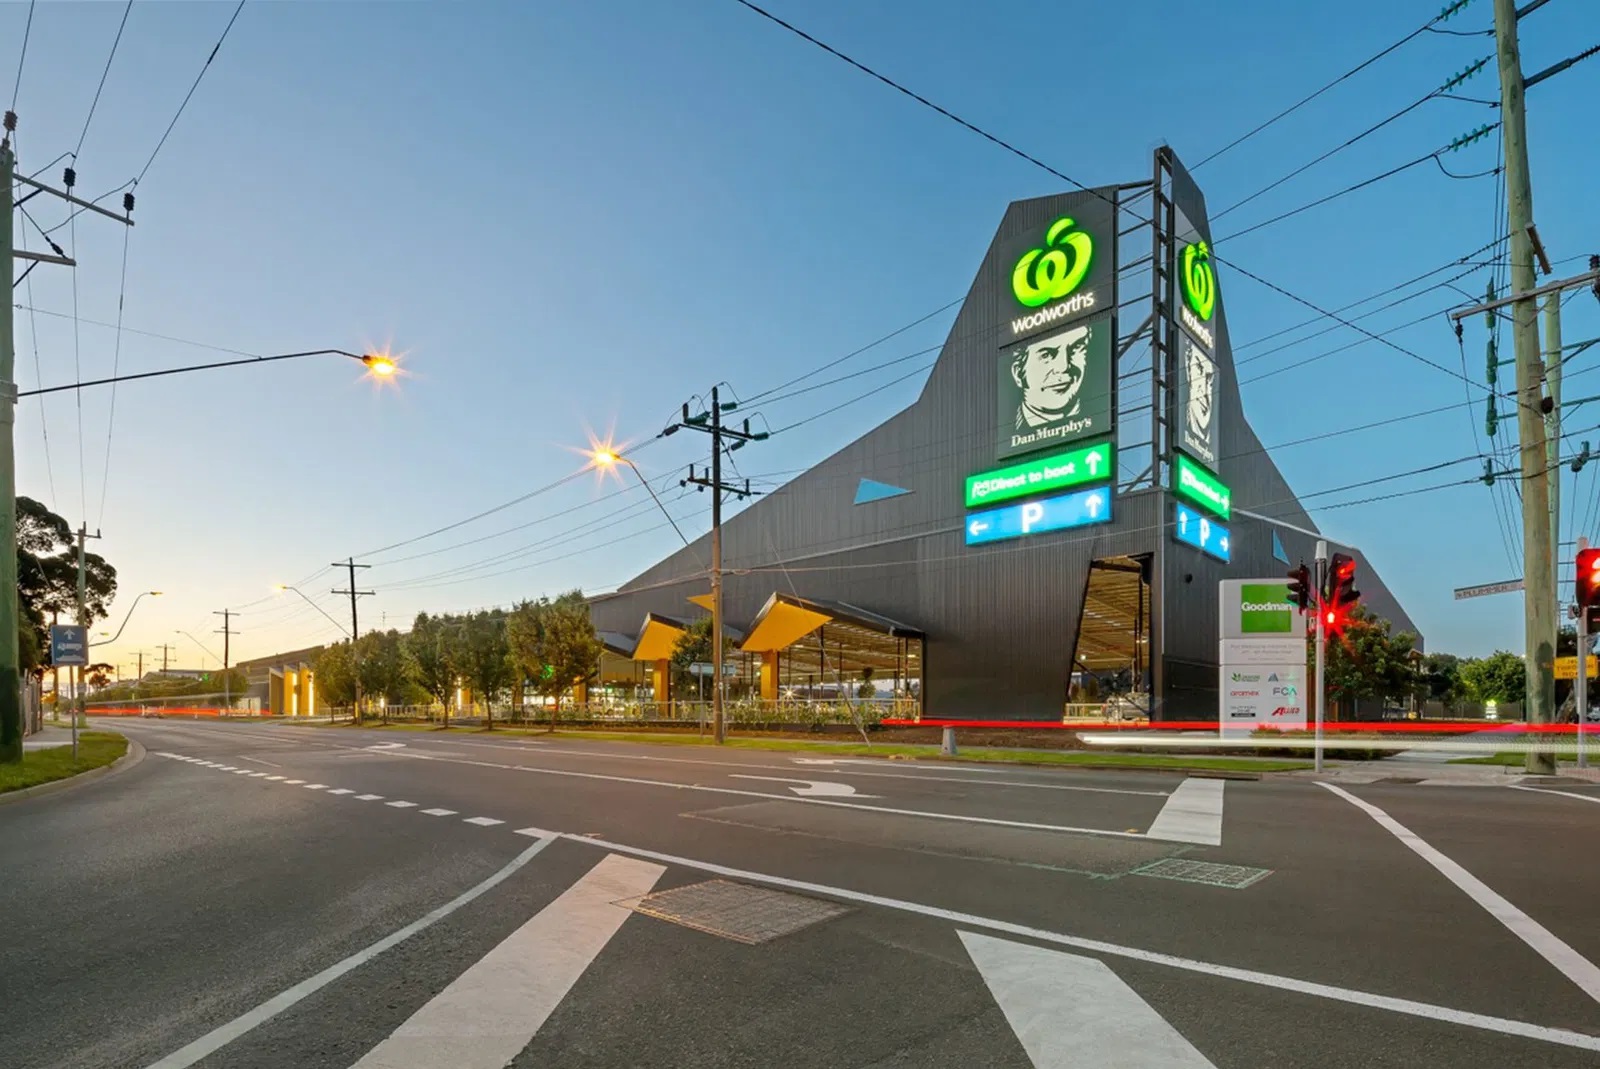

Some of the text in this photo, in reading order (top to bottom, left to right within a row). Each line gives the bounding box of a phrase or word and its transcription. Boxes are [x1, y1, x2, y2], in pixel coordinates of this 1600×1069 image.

[1012, 292, 1095, 335] Woolworths
[1011, 417, 1093, 448] Dan Murphy's
[989, 461, 1075, 491] Direct to boot
[1022, 502, 1044, 533] P
[1200, 518, 1210, 547] P
[1241, 601, 1292, 611] Goodman
